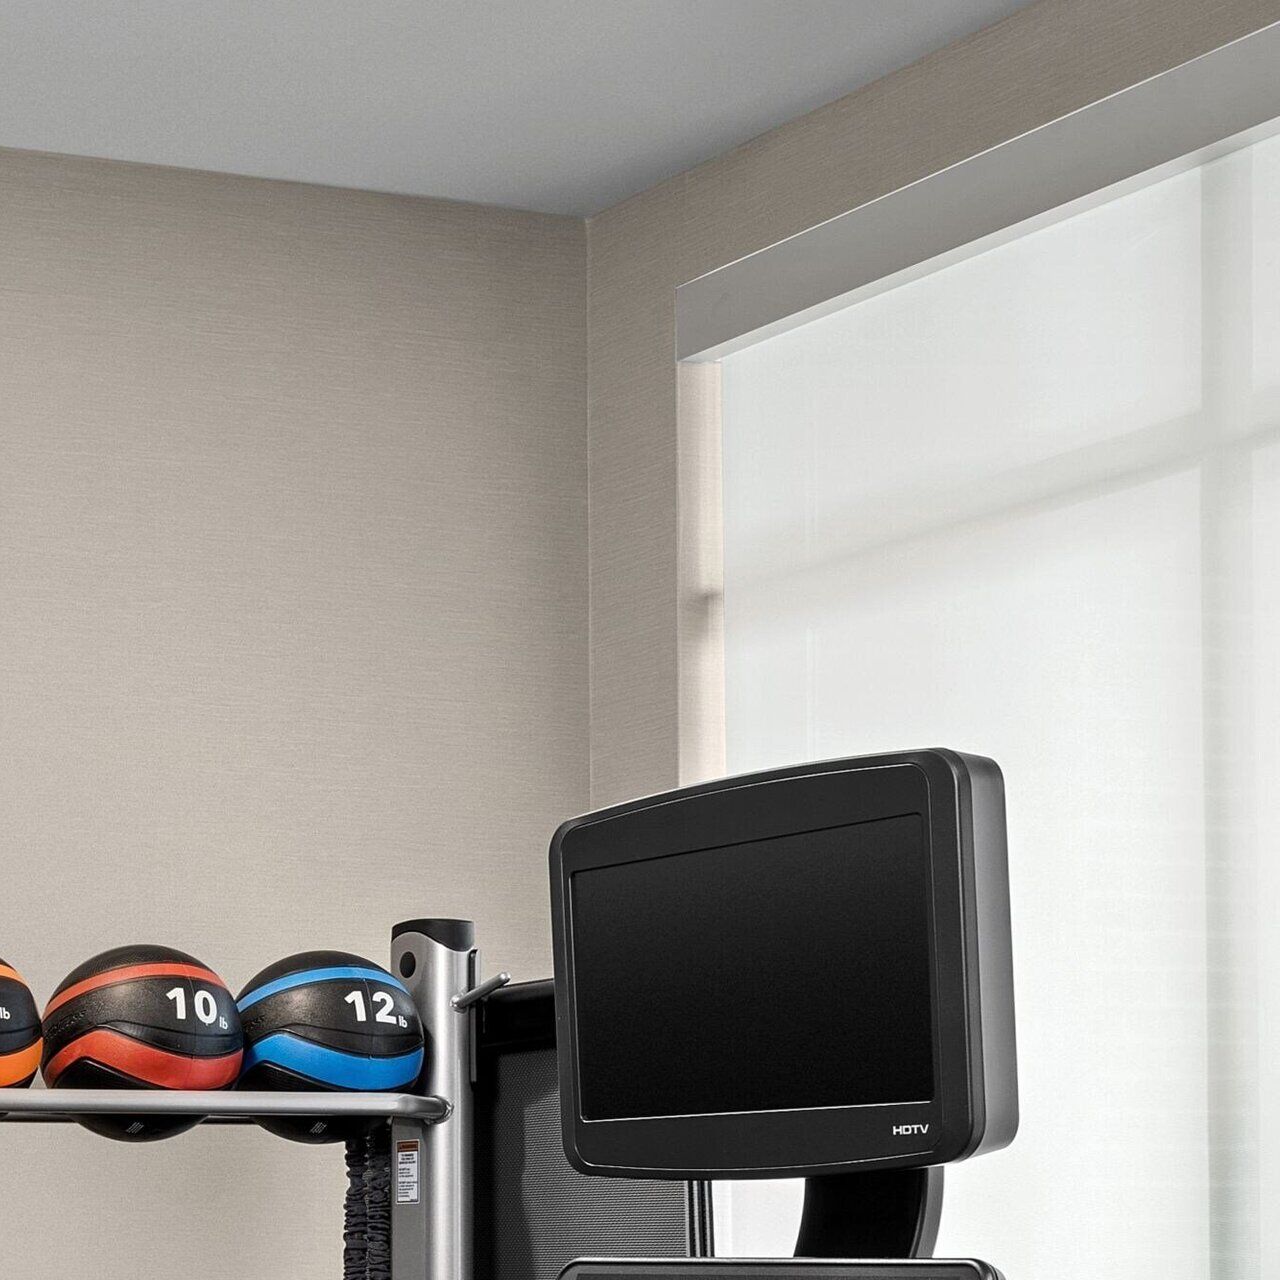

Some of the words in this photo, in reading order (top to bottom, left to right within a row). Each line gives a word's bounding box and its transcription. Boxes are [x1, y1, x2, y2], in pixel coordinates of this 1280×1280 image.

[0, 1006, 11, 1020] lb
[166, 987, 218, 1024] 10
[219, 1016, 229, 1030] lb
[344, 990, 397, 1025] 12
[398, 1015, 408, 1028] lb
[892, 1124, 929, 1135] HDTV
